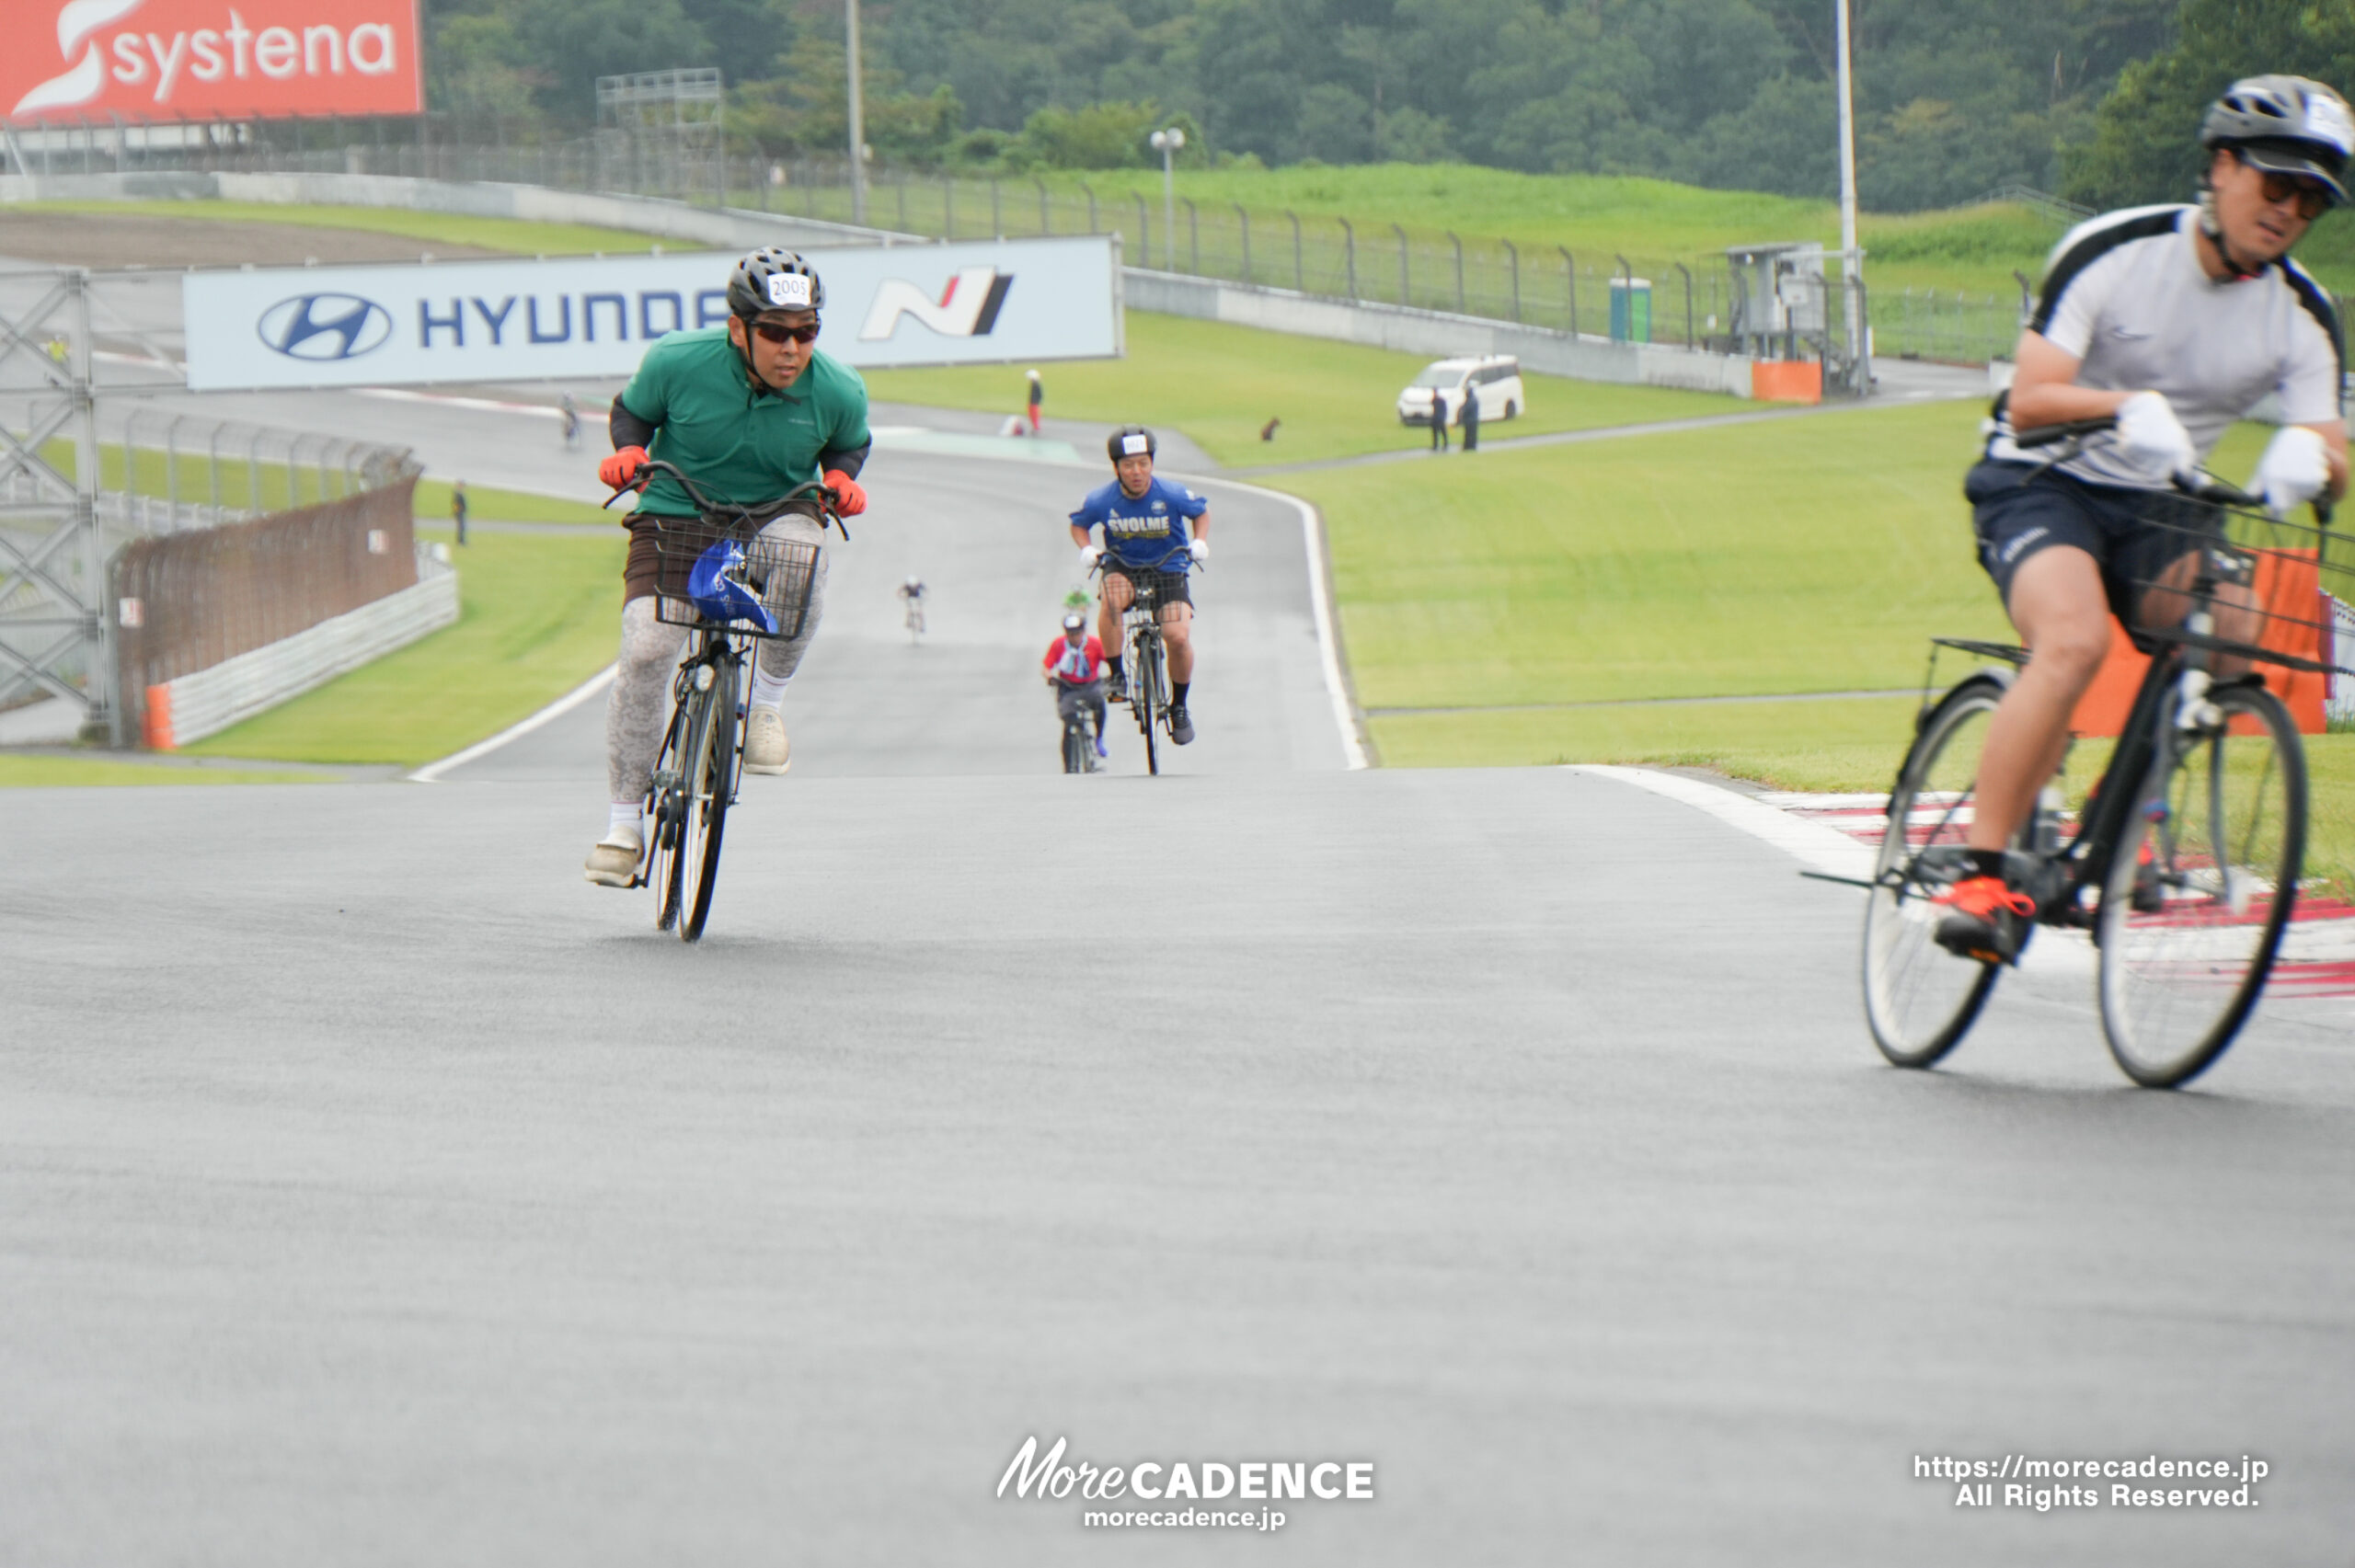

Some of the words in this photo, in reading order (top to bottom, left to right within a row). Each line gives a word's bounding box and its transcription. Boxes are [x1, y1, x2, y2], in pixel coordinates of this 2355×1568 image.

[111, 6, 397, 103] systena
[419, 289, 729, 348] HYUNDA
[1107, 515, 1170, 532] SVOLME
